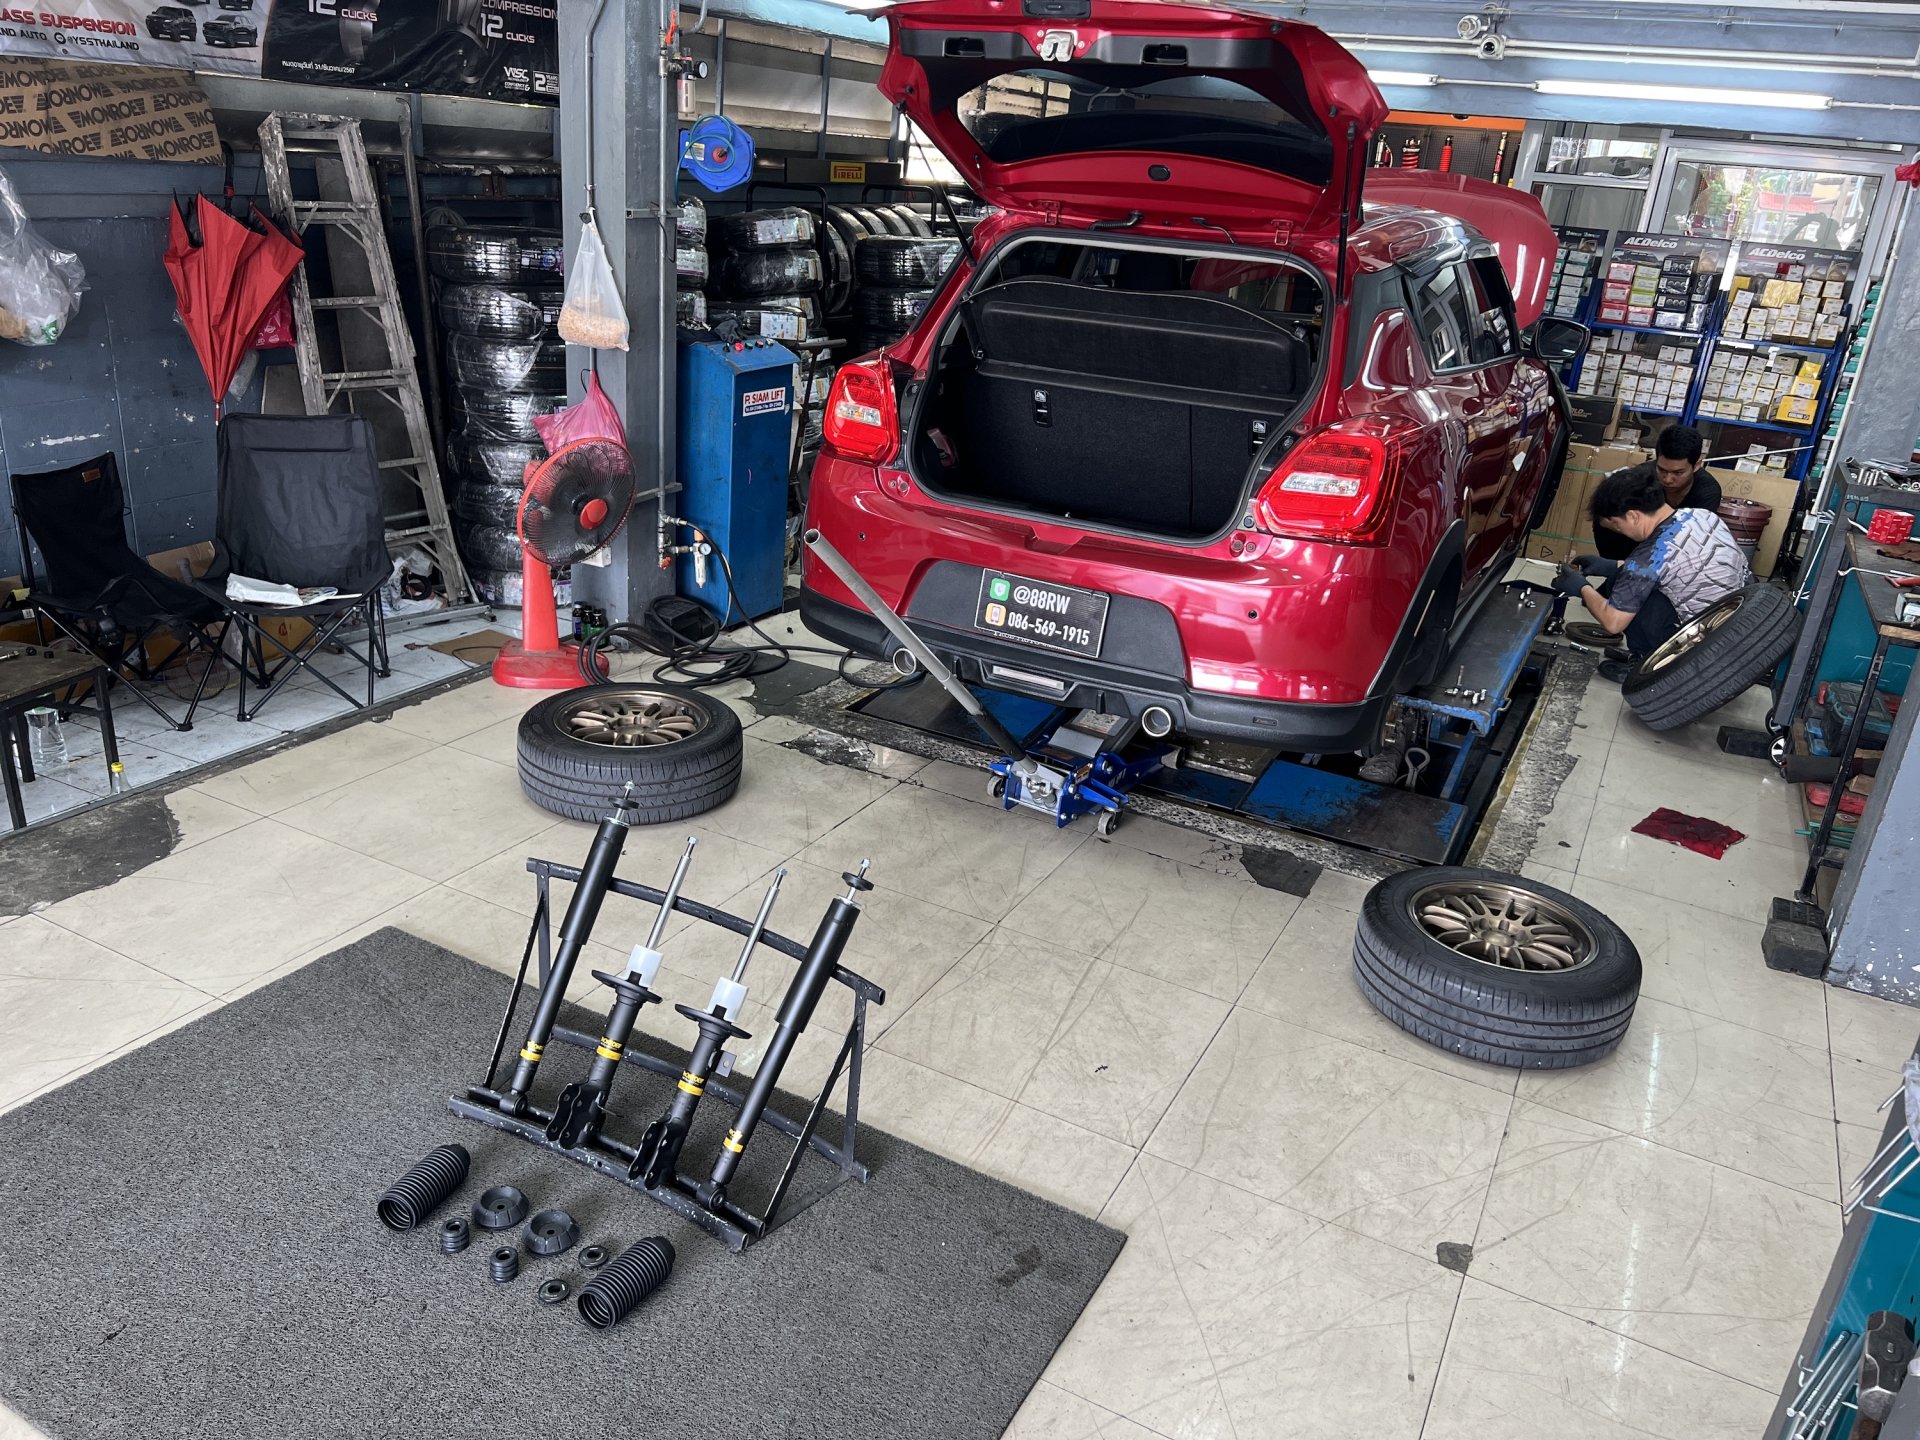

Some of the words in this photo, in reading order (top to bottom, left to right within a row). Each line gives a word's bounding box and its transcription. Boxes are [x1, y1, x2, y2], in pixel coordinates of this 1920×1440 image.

[0, 8, 36, 25] ASS
[39, 13, 137, 36] SUSPENSION
[341, 8, 378, 22] CLICKS
[20, 29, 47, 41] AUTO
[67, 36, 140, 51] @YSSTHAILAND
[480, 13, 504, 39] 12
[506, 31, 535, 44] CLICKS
[534, 73, 546, 92] 2
[67, 98, 146, 128] MONROE
[110, 116, 186, 147] MONROE
[142, 130, 215, 161] MONROE
[833, 166, 863, 179] PIRELLI
[1623, 236, 1678, 249] ACDelco
[1748, 247, 1806, 261] ACDelco
[752, 392, 770, 404] SIAM
[771, 389, 784, 400] LIFT
[1013, 585, 1071, 615] @88RW
[1007, 611, 1091, 646] 086-569-1915
